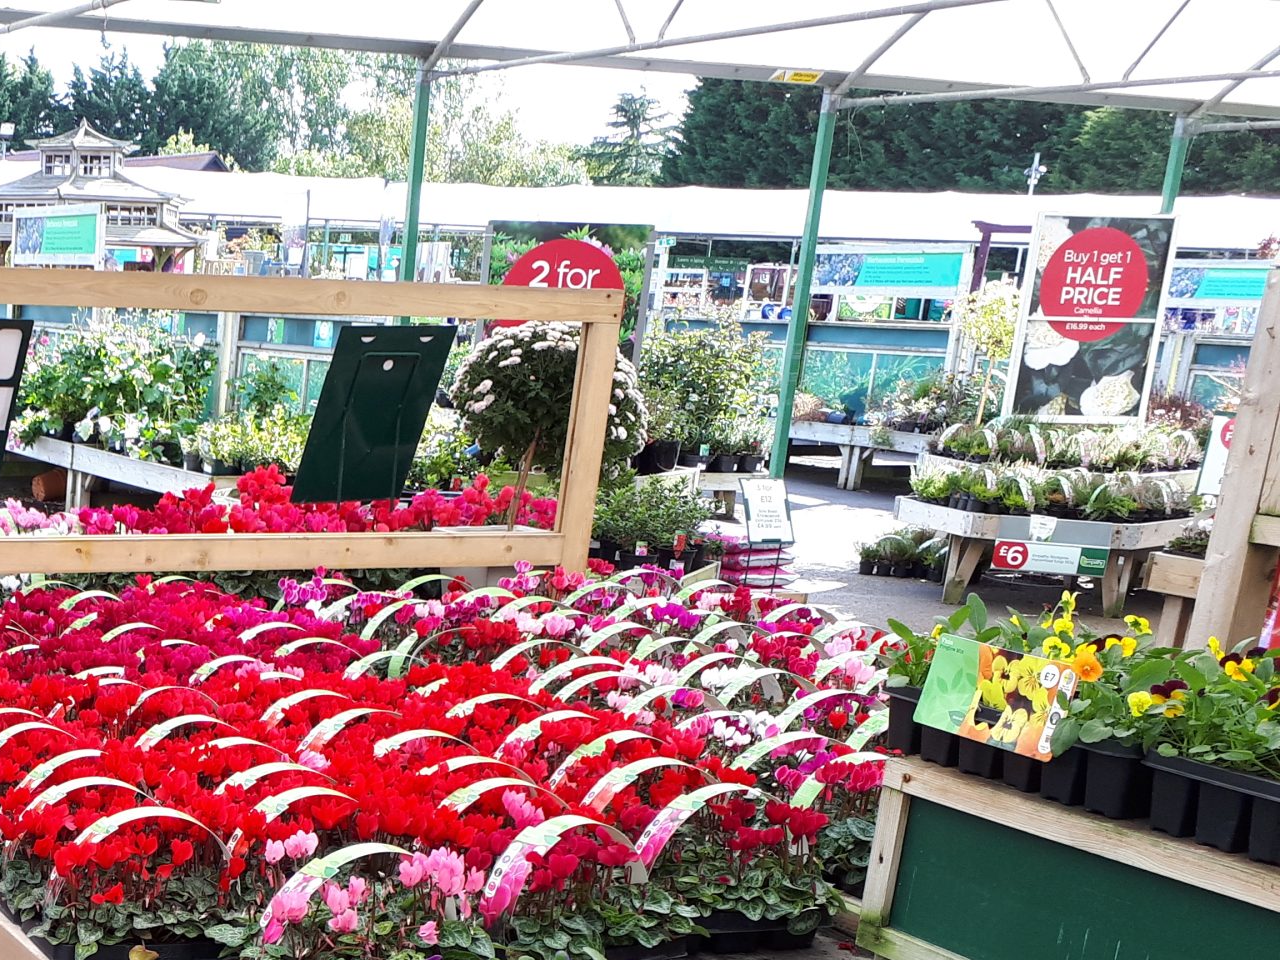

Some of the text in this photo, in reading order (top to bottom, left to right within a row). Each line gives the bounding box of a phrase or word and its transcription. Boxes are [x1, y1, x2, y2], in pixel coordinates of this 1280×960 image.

[1064, 250, 1132, 265] Buy 1 get 1
[529, 260, 600, 289] 2 for
[1066, 267, 1123, 284] HALF
[1060, 287, 1122, 305] PRICE
[999, 545, 1025, 566] £6
[1044, 672, 1056, 682] £7
